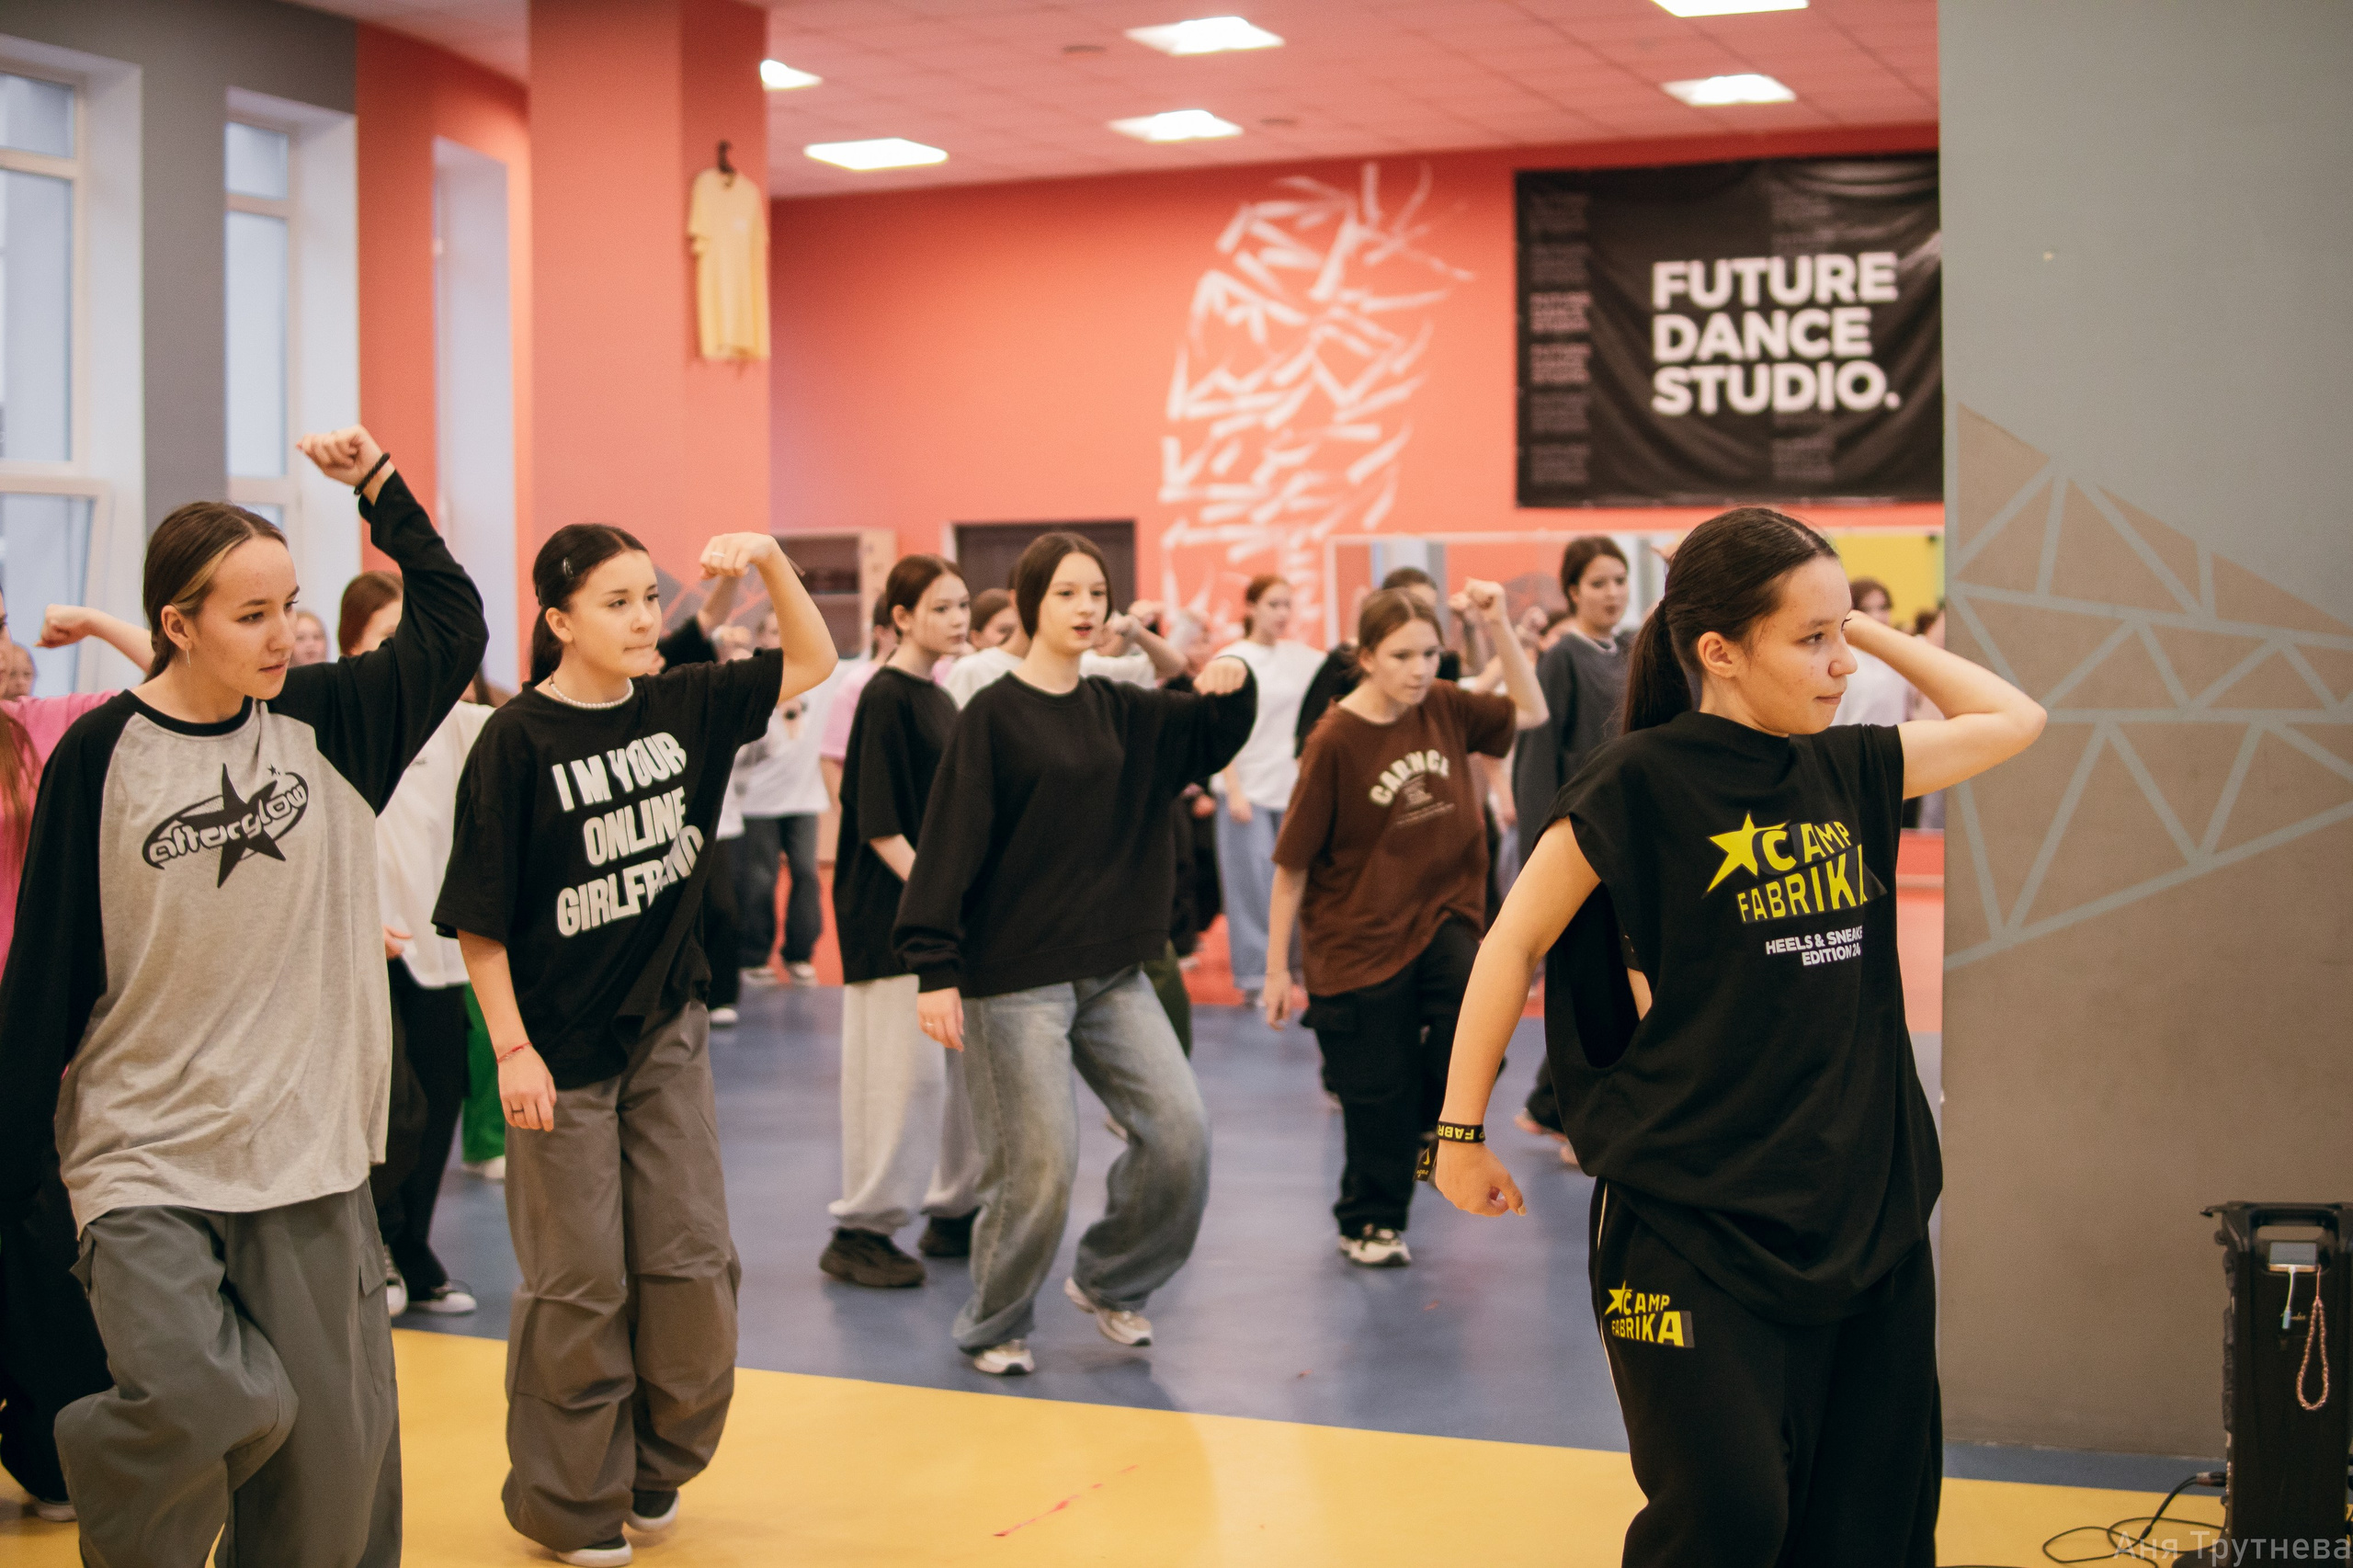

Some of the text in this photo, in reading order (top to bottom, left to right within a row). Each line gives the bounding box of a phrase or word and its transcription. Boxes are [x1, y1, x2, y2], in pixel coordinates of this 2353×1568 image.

[1653, 252, 1898, 308] FUTURE
[1653, 307, 1872, 362] DANCE
[1652, 360, 1901, 415] STUDIO.
[607, 732, 687, 792] YOUR
[584, 786, 686, 865] ONLINE
[1762, 822, 1852, 871] CAMP
[1765, 935, 1813, 955] HEELS
[1814, 933, 1825, 948] &
[1802, 945, 1852, 966] EDITION
[1623, 1290, 1670, 1315] CAMP
[1611, 1311, 1684, 1347] FABRIKA
